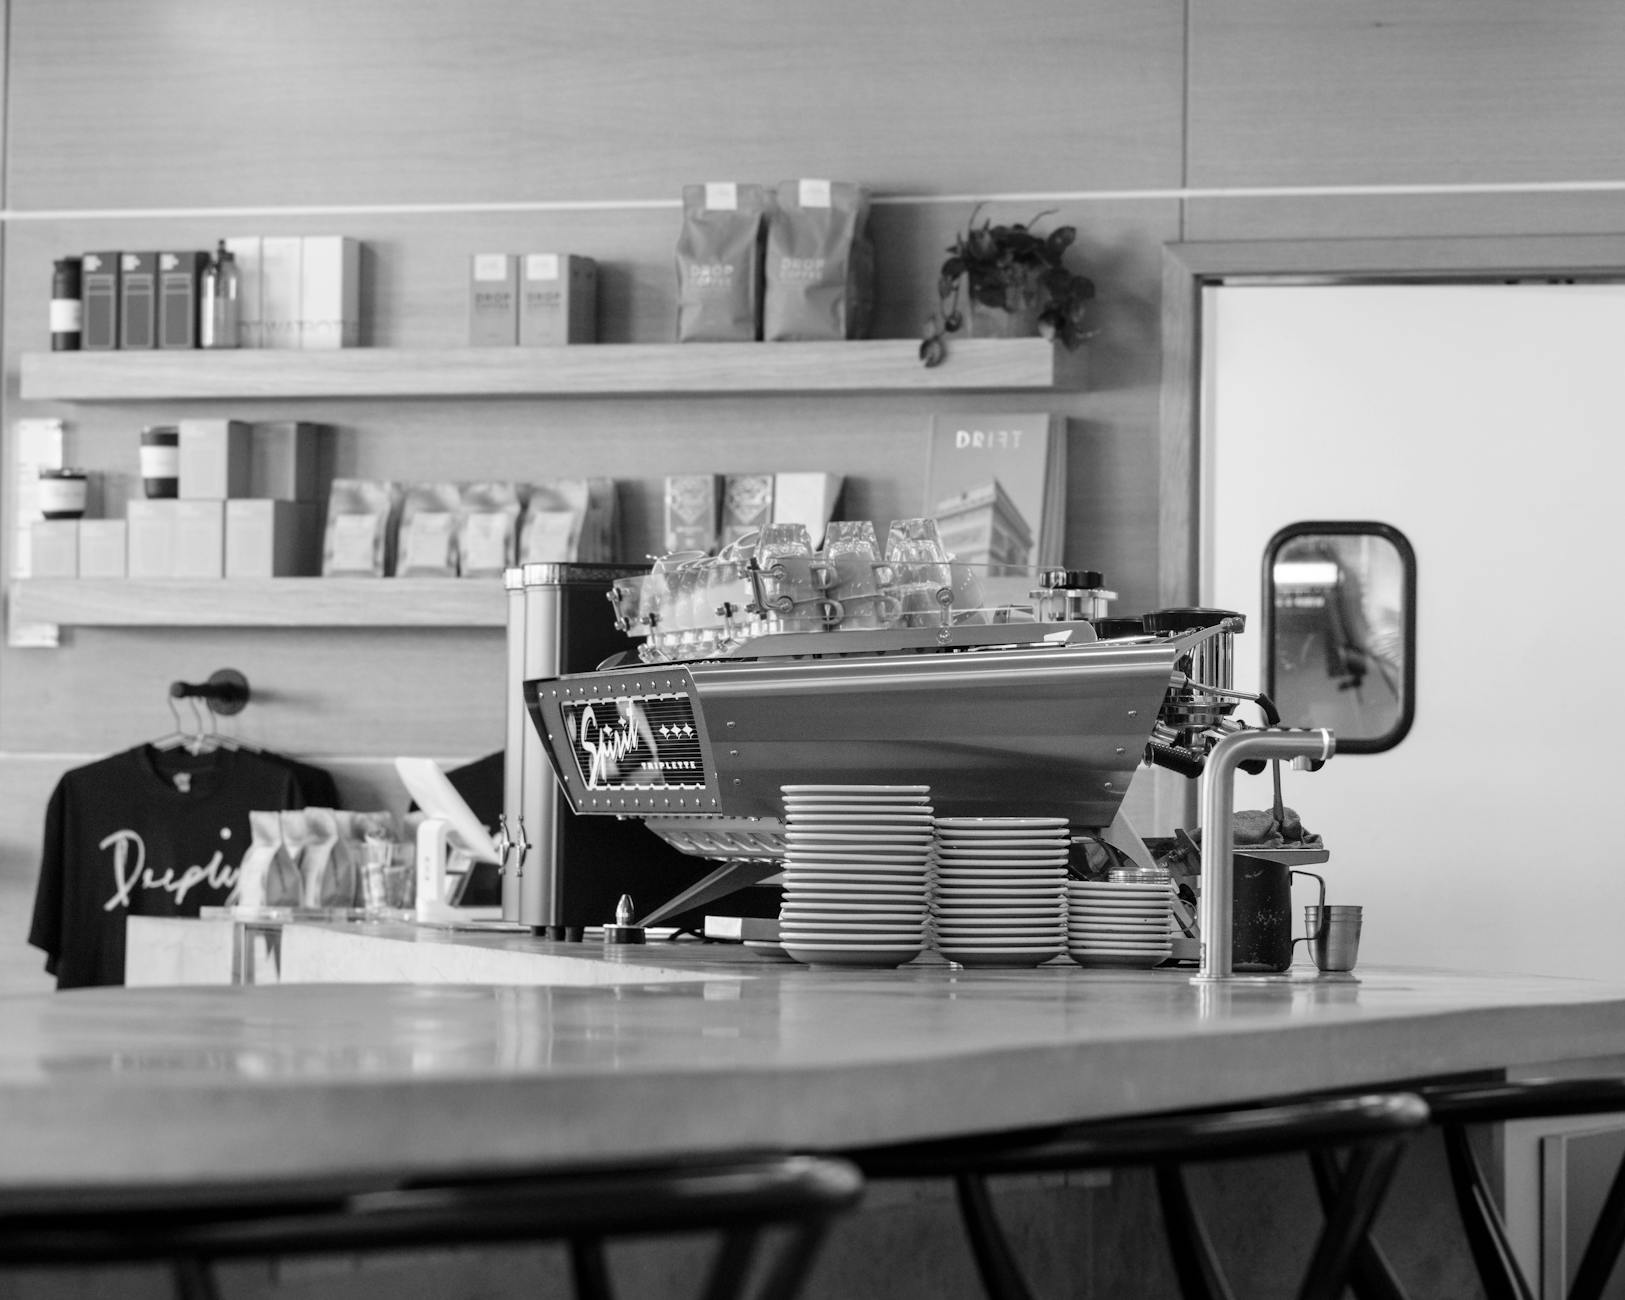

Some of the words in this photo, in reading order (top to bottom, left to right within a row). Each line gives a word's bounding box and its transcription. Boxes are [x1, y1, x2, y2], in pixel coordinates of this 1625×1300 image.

[690, 264, 734, 276] DROP
[956, 430, 1023, 449] DRIFT
[641, 761, 697, 771] TRIPLETTE
